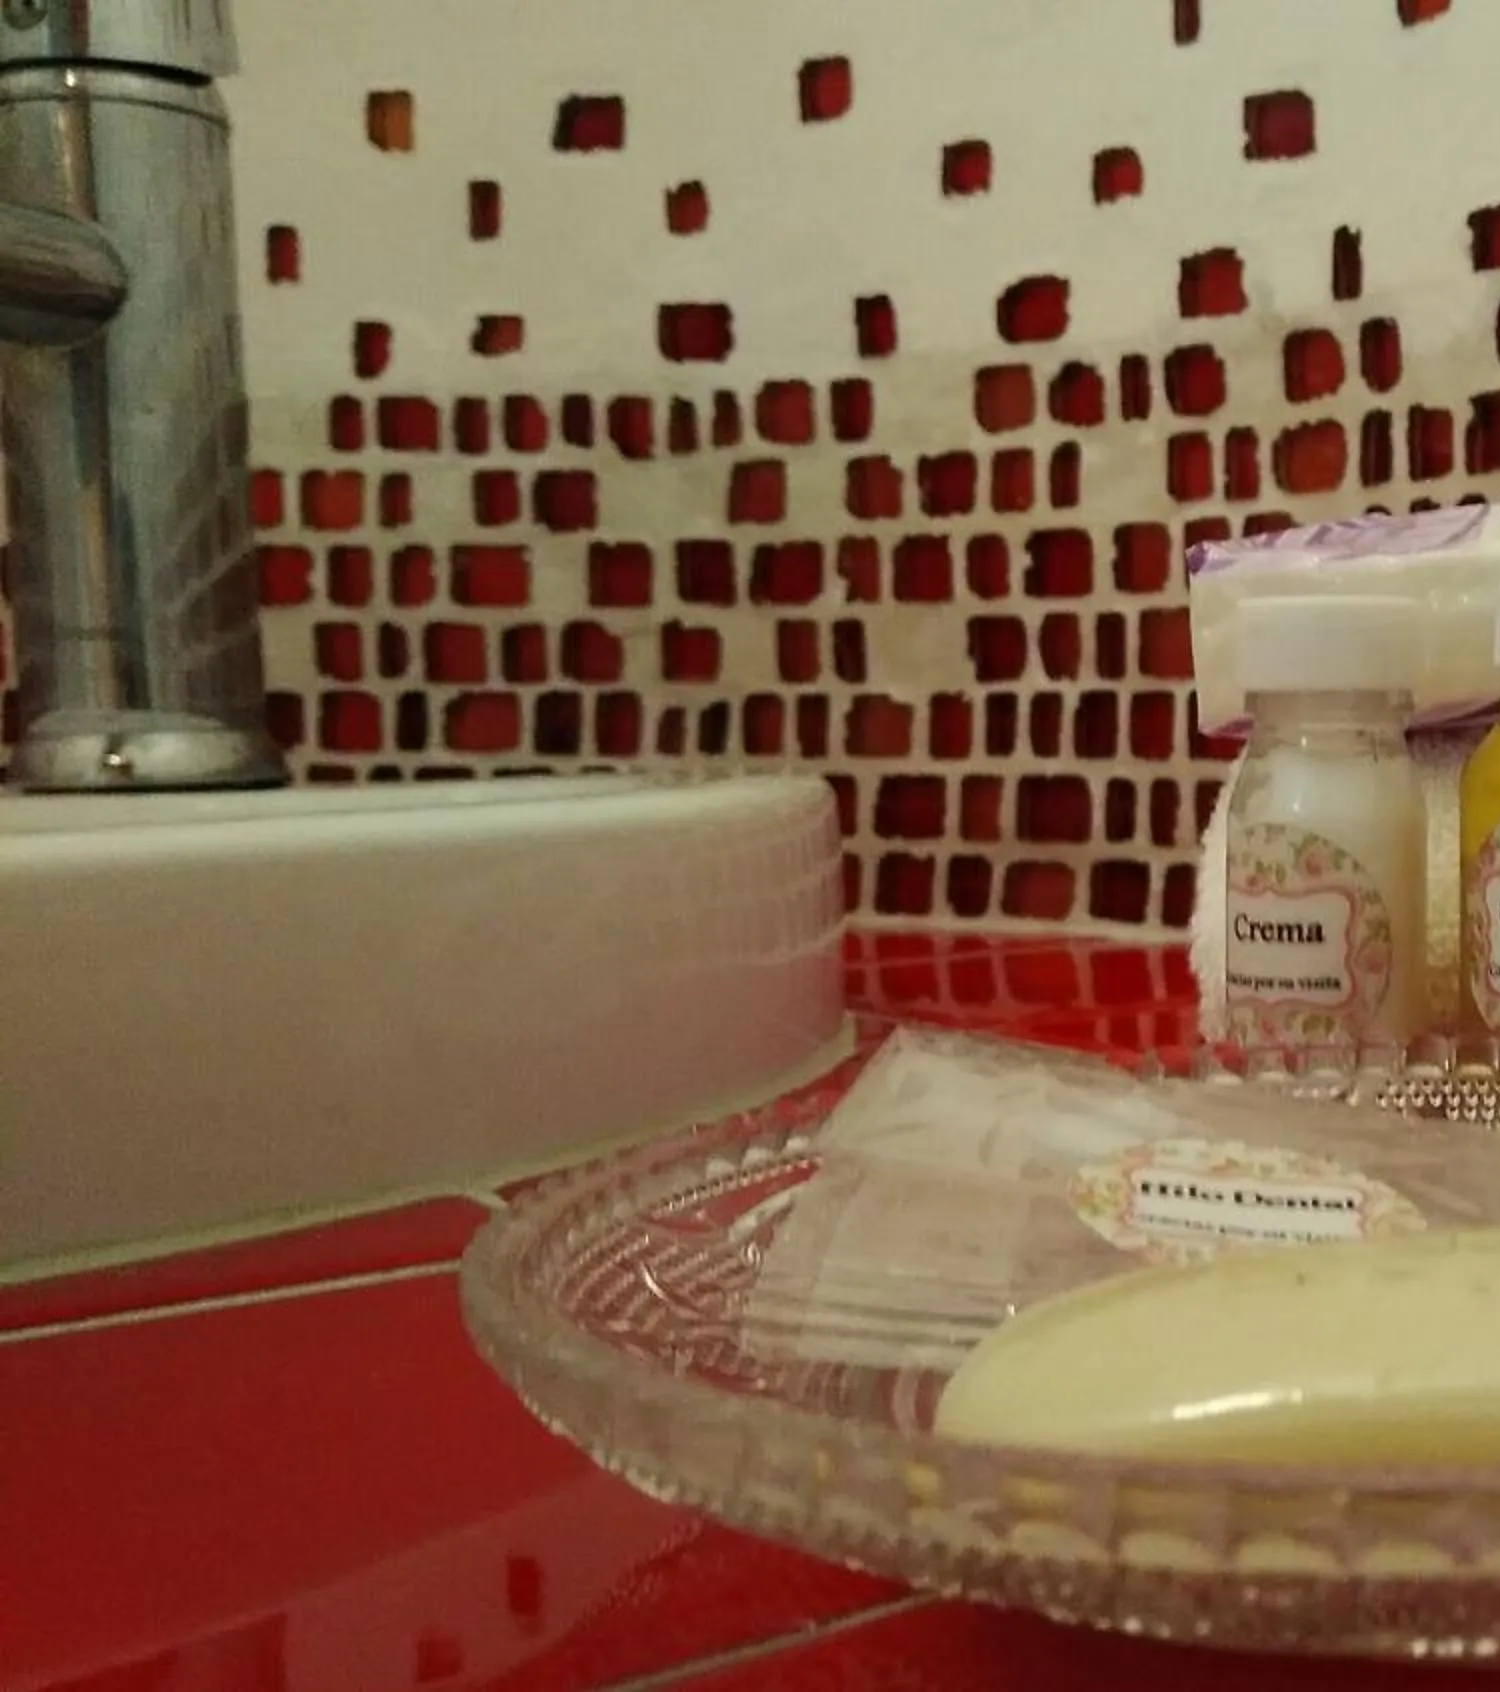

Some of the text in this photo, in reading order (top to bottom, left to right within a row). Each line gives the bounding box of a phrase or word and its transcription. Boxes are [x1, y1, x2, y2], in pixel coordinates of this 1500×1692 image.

[1233, 912, 1325, 944] Crema
[1140, 1180, 1356, 1211] Hilo Dental
